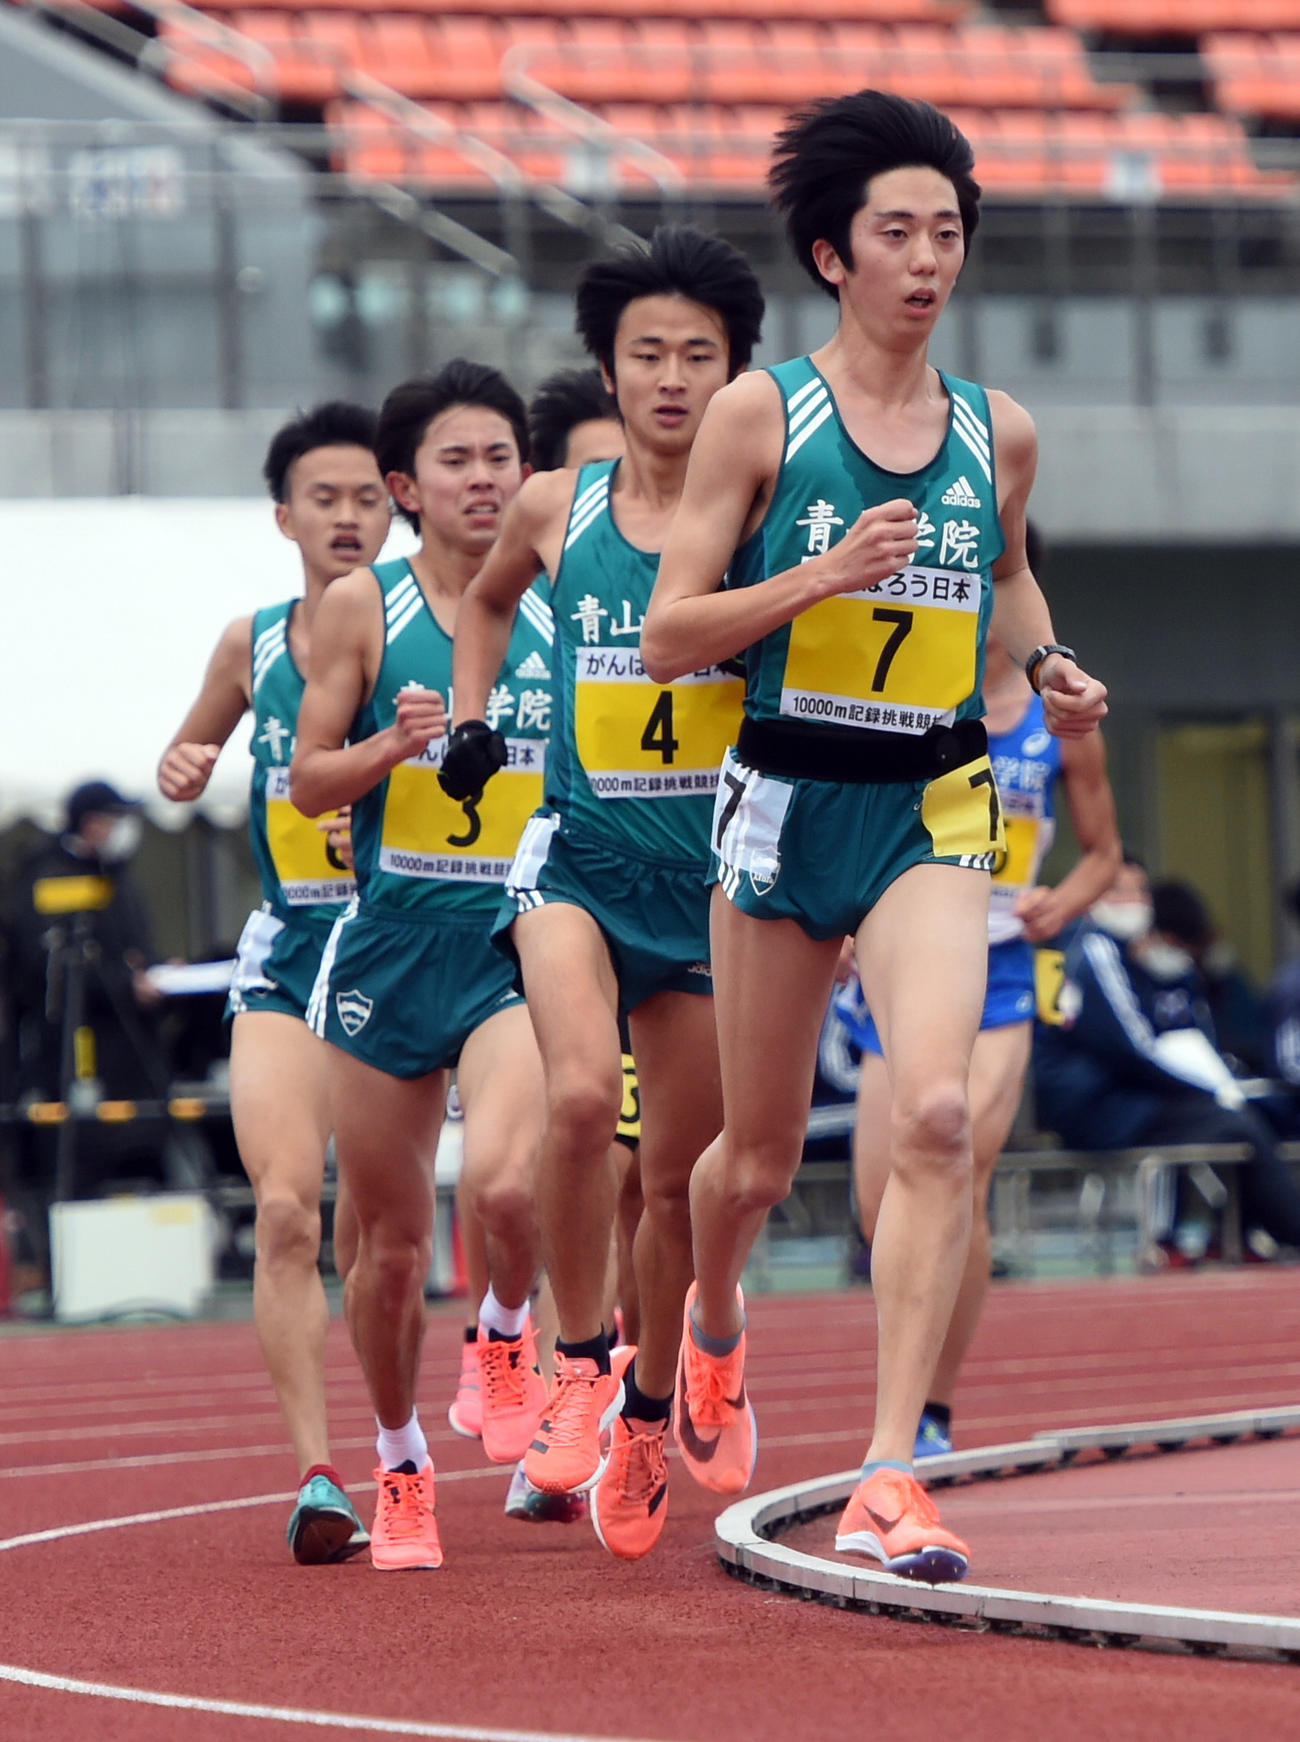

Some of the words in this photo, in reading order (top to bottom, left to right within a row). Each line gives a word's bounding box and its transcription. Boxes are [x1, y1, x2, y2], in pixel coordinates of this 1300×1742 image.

[941, 495, 981, 508] adidas
[872, 608, 913, 692] 7
[641, 691, 678, 764] 4
[446, 786, 483, 847] 3
[716, 771, 746, 850] 7
[968, 768, 999, 842] 7
